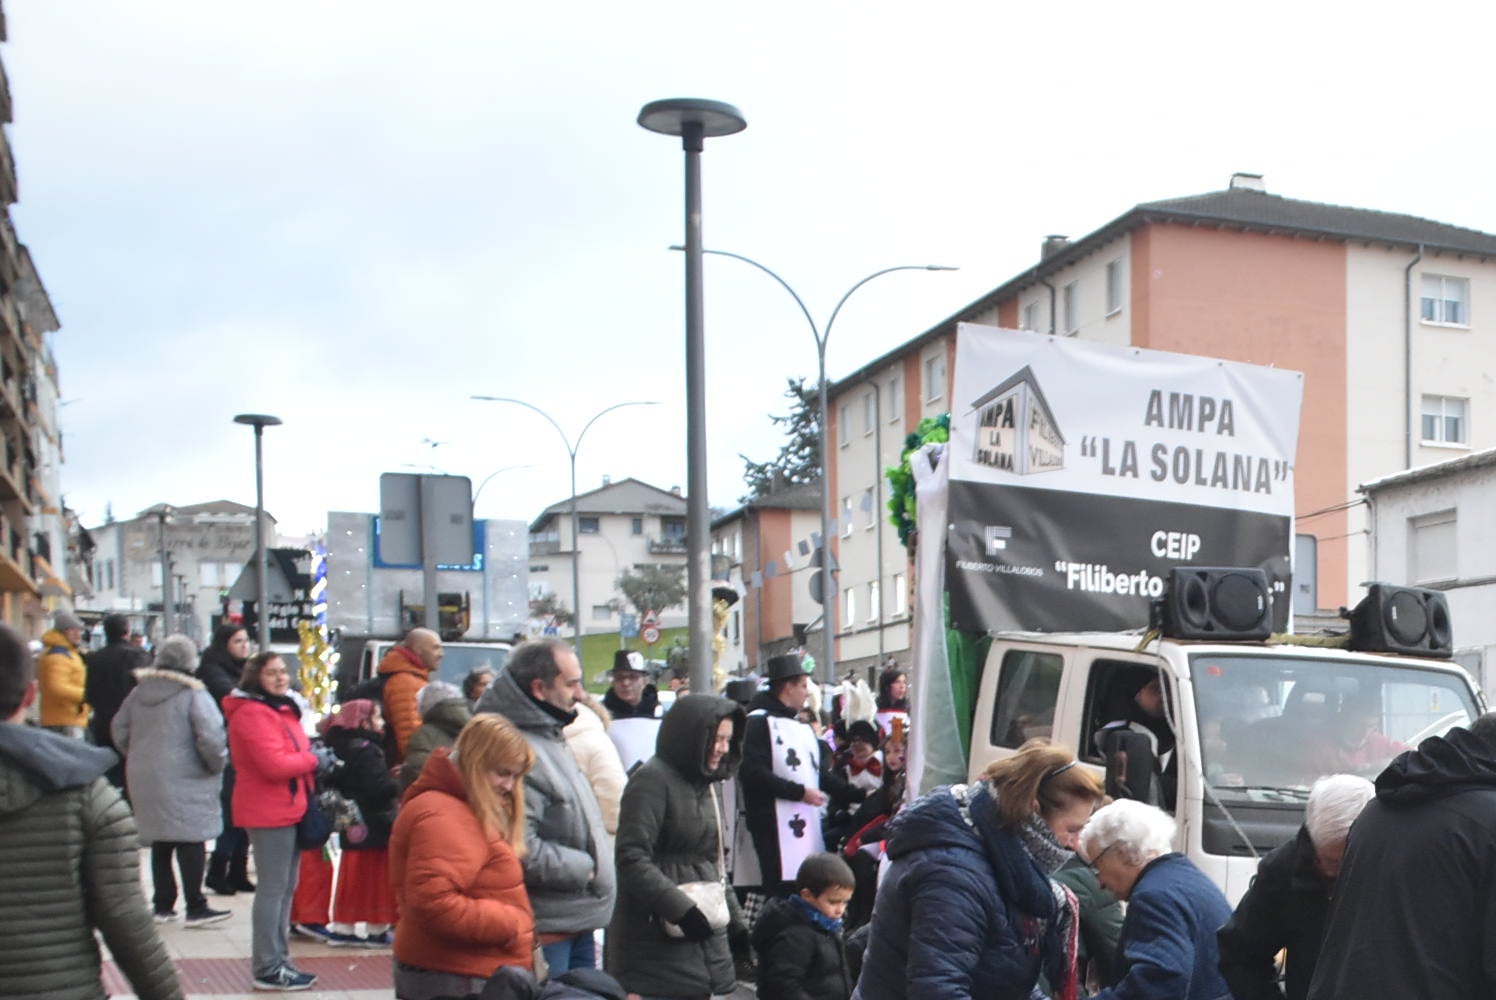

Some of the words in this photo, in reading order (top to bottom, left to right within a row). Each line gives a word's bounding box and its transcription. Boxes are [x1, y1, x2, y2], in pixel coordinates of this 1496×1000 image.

[1144, 389, 1236, 438] AMPA
[1150, 530, 1201, 561] CEIP
[956, 560, 993, 573] FILIBERTO
[995, 565, 1044, 578] VILLALOBOS
